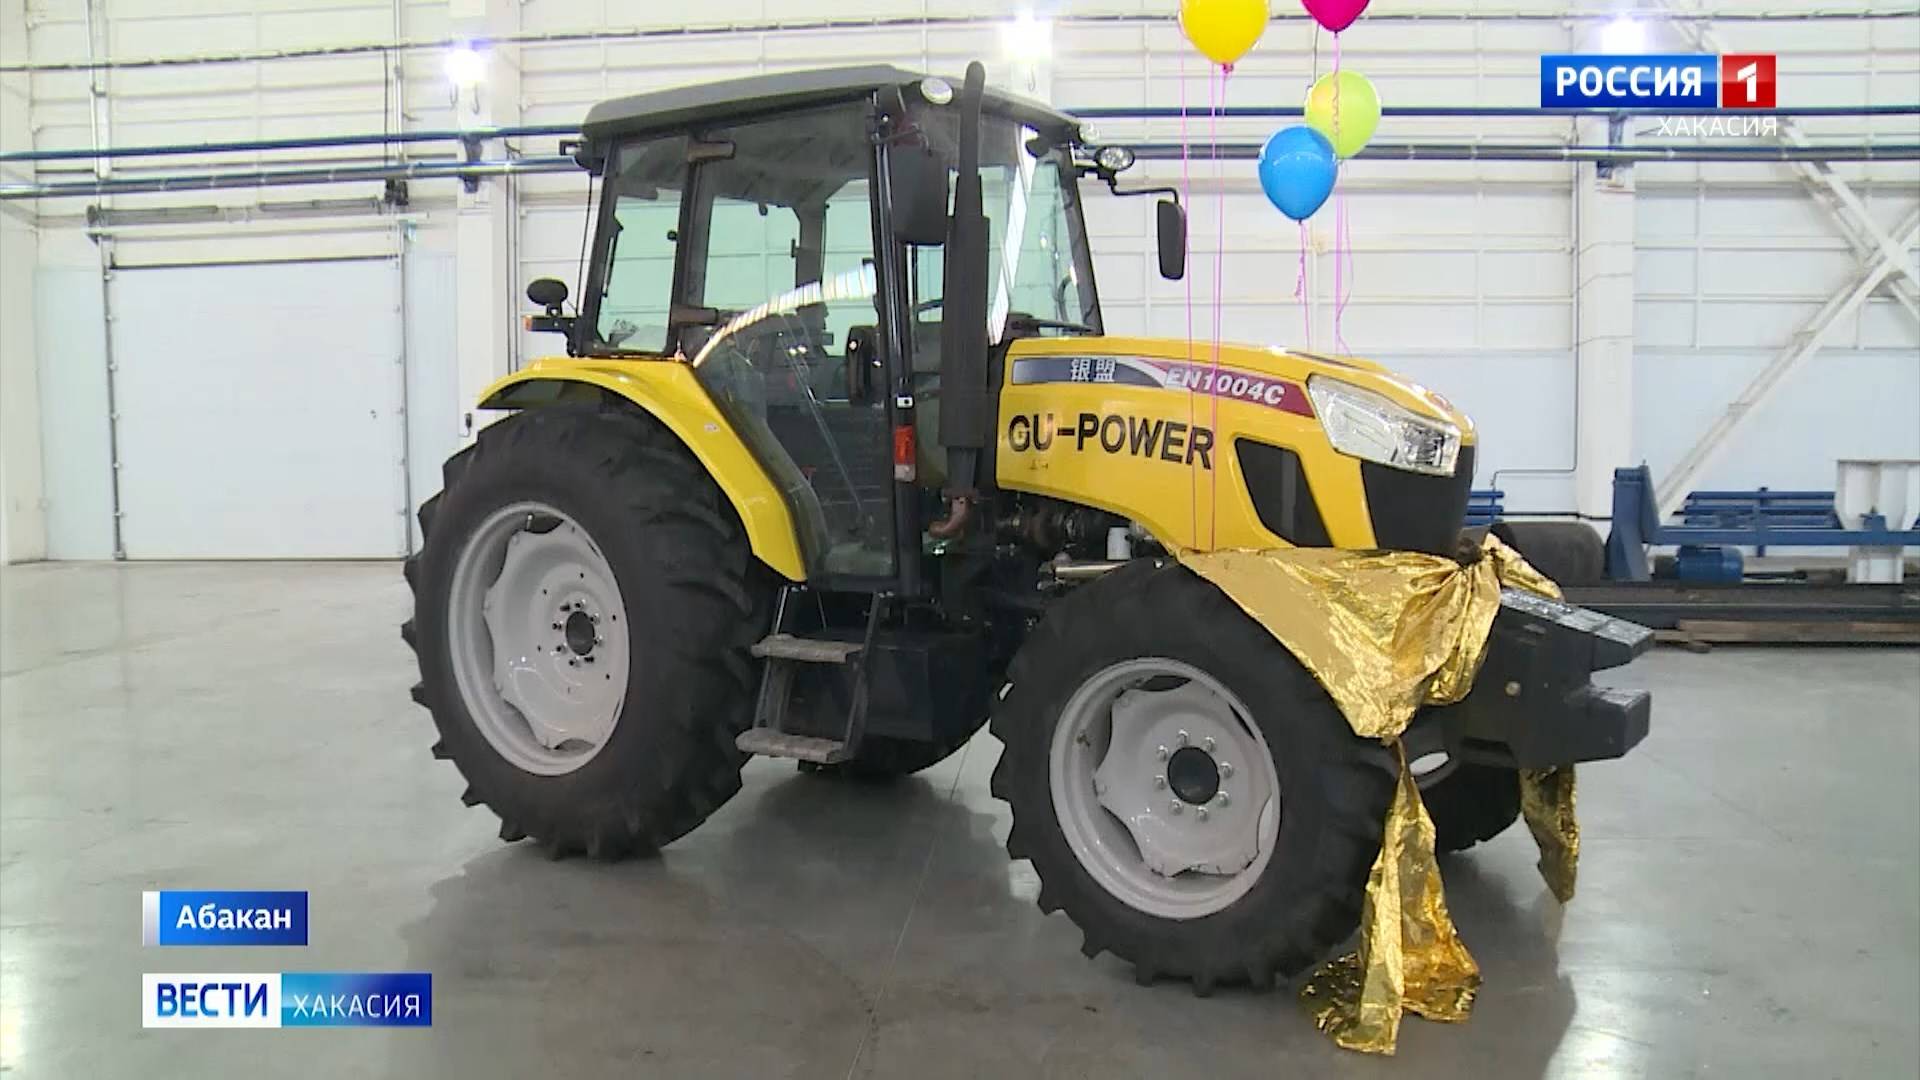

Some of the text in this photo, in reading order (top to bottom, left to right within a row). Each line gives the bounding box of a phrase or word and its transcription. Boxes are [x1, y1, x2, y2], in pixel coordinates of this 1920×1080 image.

[1070, 357, 1116, 383] 银盟
[1165, 366, 1286, 405] EN1004C
[1008, 412, 1215, 470] GU-POWER
